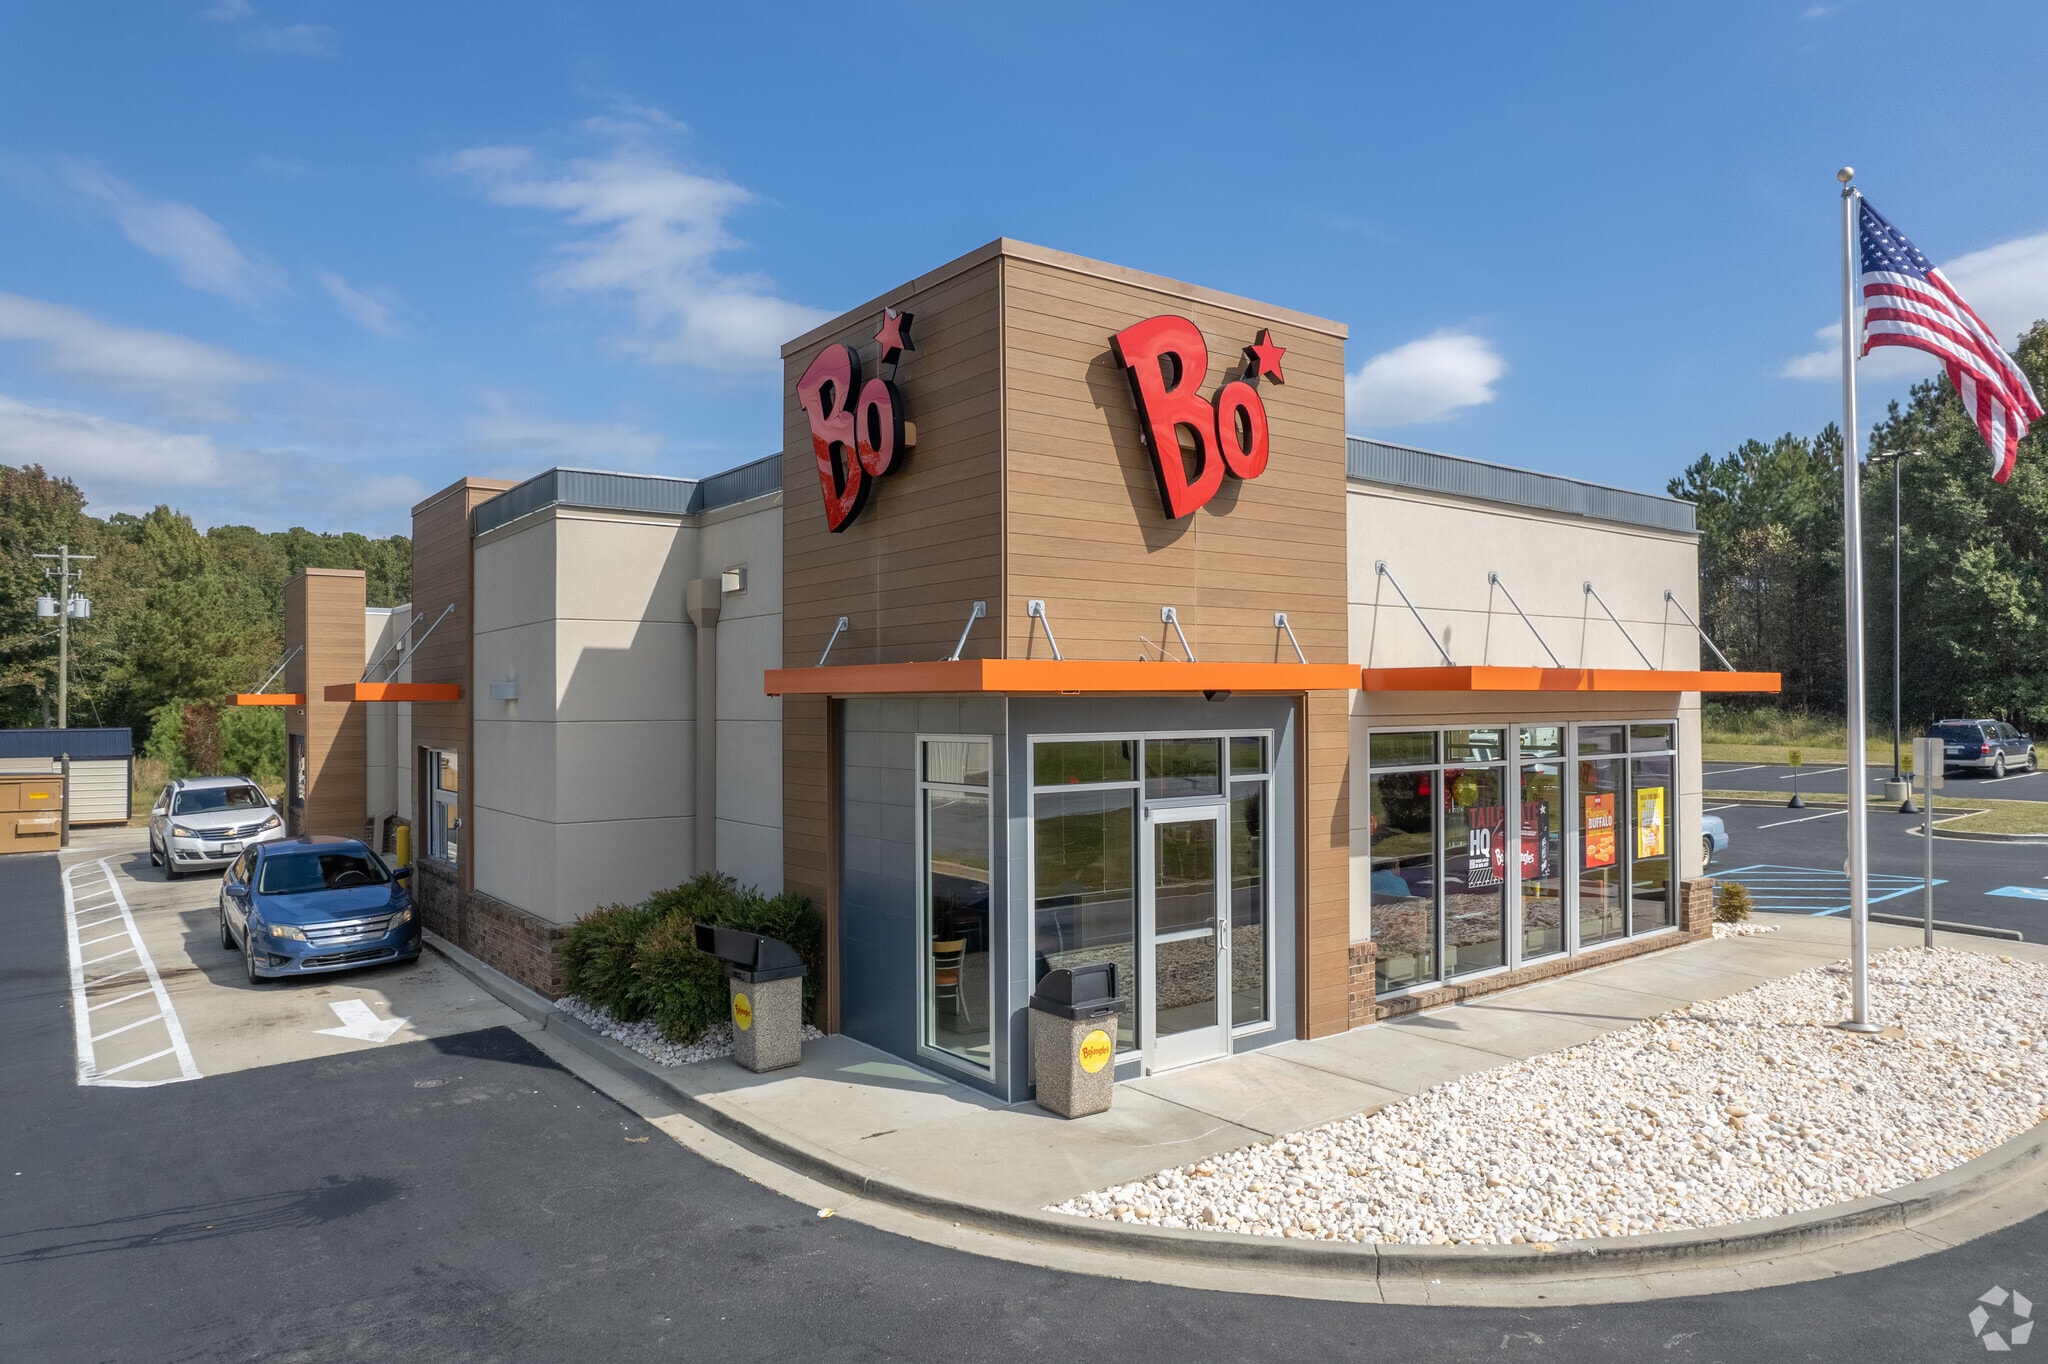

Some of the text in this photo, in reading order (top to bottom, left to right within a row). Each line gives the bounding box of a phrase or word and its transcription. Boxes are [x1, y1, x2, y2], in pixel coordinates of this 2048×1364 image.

[1588, 815, 1612, 829] BUFFALO
[1470, 828, 1490, 858] HQ
[1083, 1046, 1109, 1059] Bojangles
